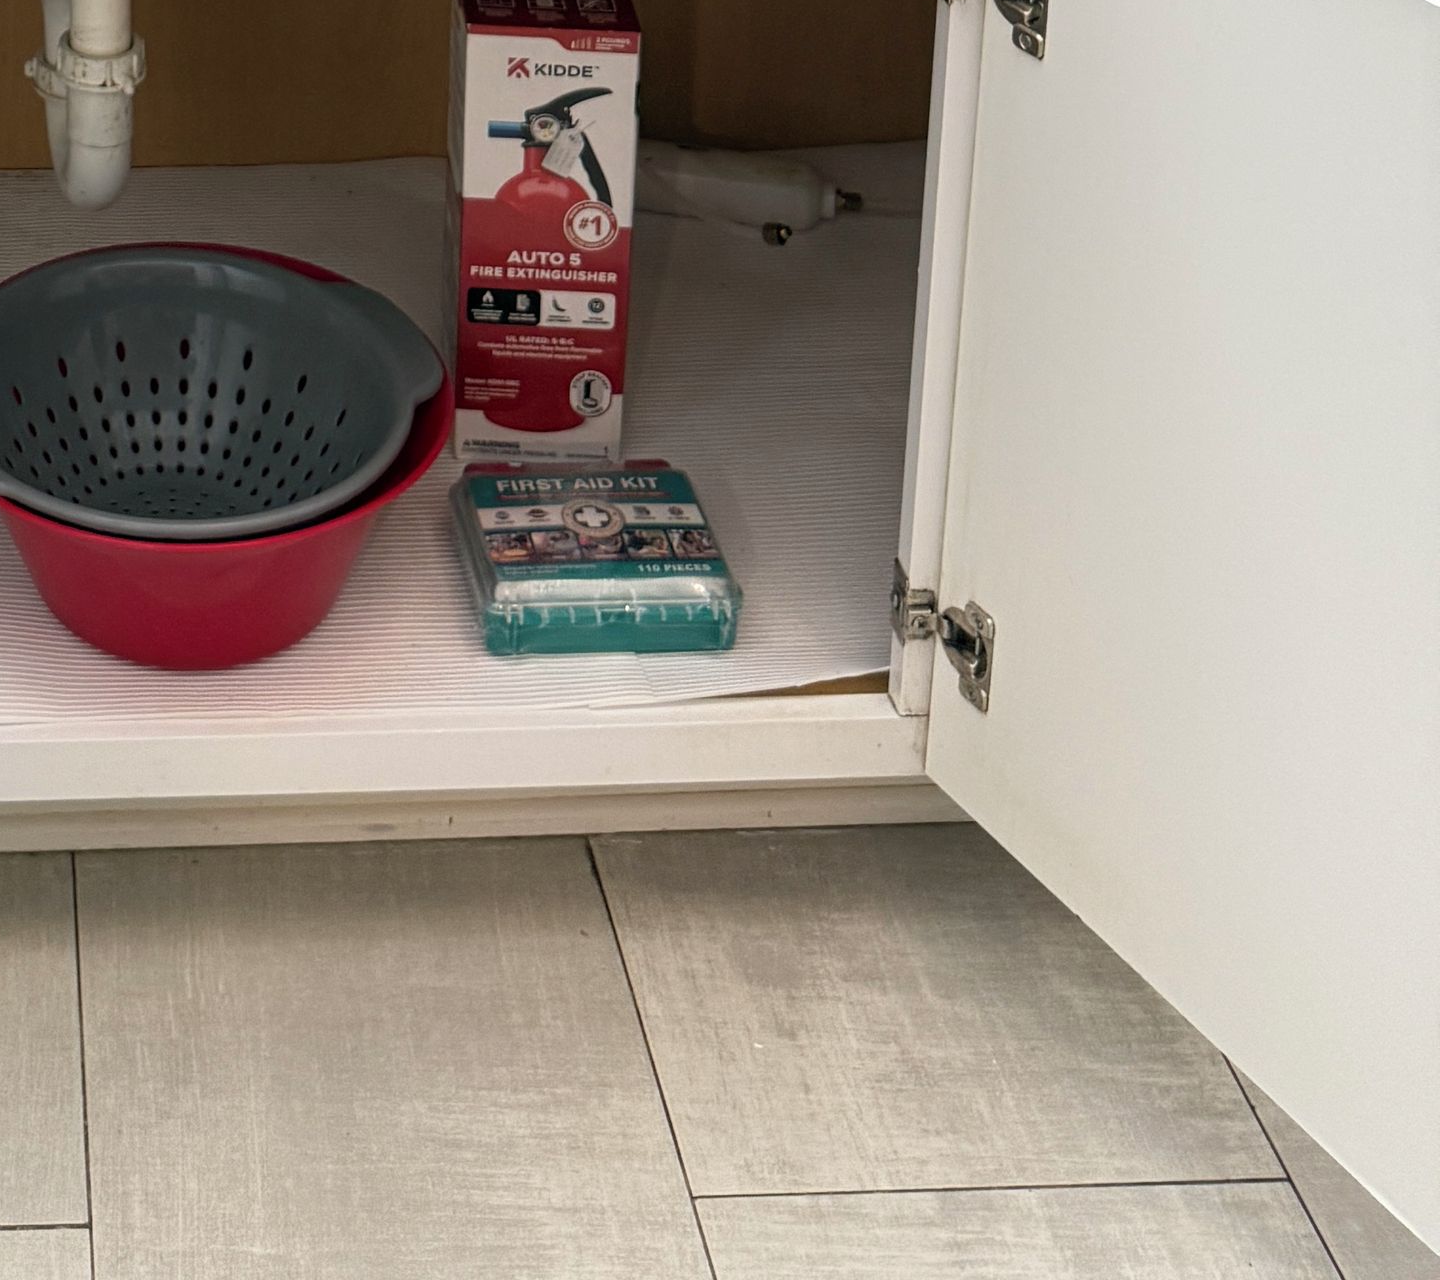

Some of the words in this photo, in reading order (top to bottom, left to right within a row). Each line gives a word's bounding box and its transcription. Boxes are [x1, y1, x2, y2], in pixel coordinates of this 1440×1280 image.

[534, 63, 594, 78] KIDDE
[577, 215, 602, 236] #1
[506, 250, 564, 265] AUTO
[569, 252, 581, 266] 5
[469, 265, 503, 277] FIRE
[506, 266, 618, 283] EXTINGUISHER
[495, 477, 564, 492] FIRST
[573, 477, 614, 490] AID
[619, 476, 659, 489] KIT
[663, 563, 712, 572] PIECES
